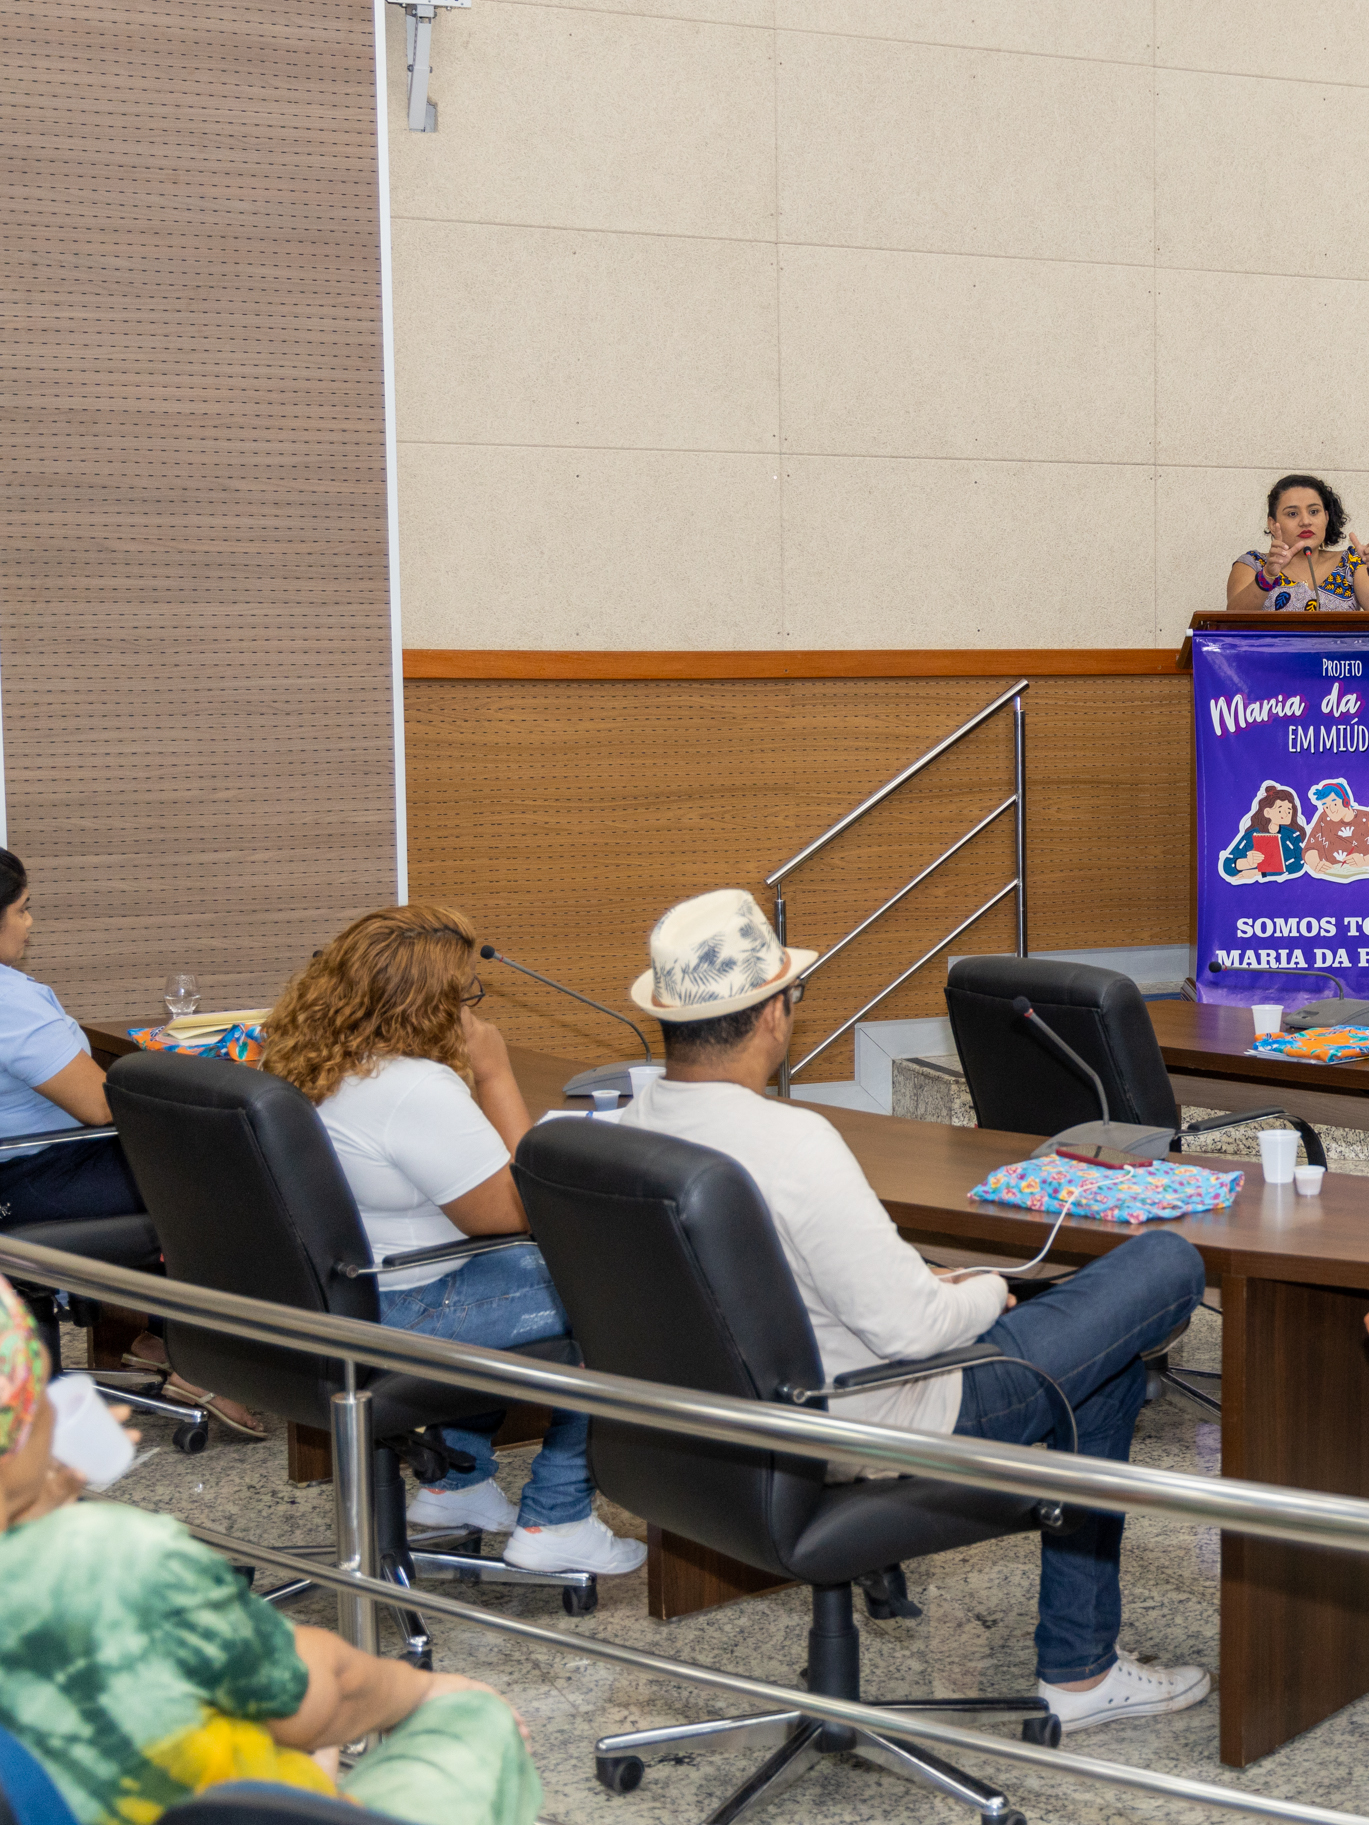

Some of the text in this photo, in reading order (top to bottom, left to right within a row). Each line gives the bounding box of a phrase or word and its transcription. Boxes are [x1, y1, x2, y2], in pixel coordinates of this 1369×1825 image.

[1210, 694, 1305, 736] Maria
[1321, 682, 1361, 717] da
[1288, 725, 1315, 753] EM
[1236, 917, 1337, 938] SOMOS
[1216, 949, 1308, 968] MARIA
[1314, 948, 1352, 968] DA
